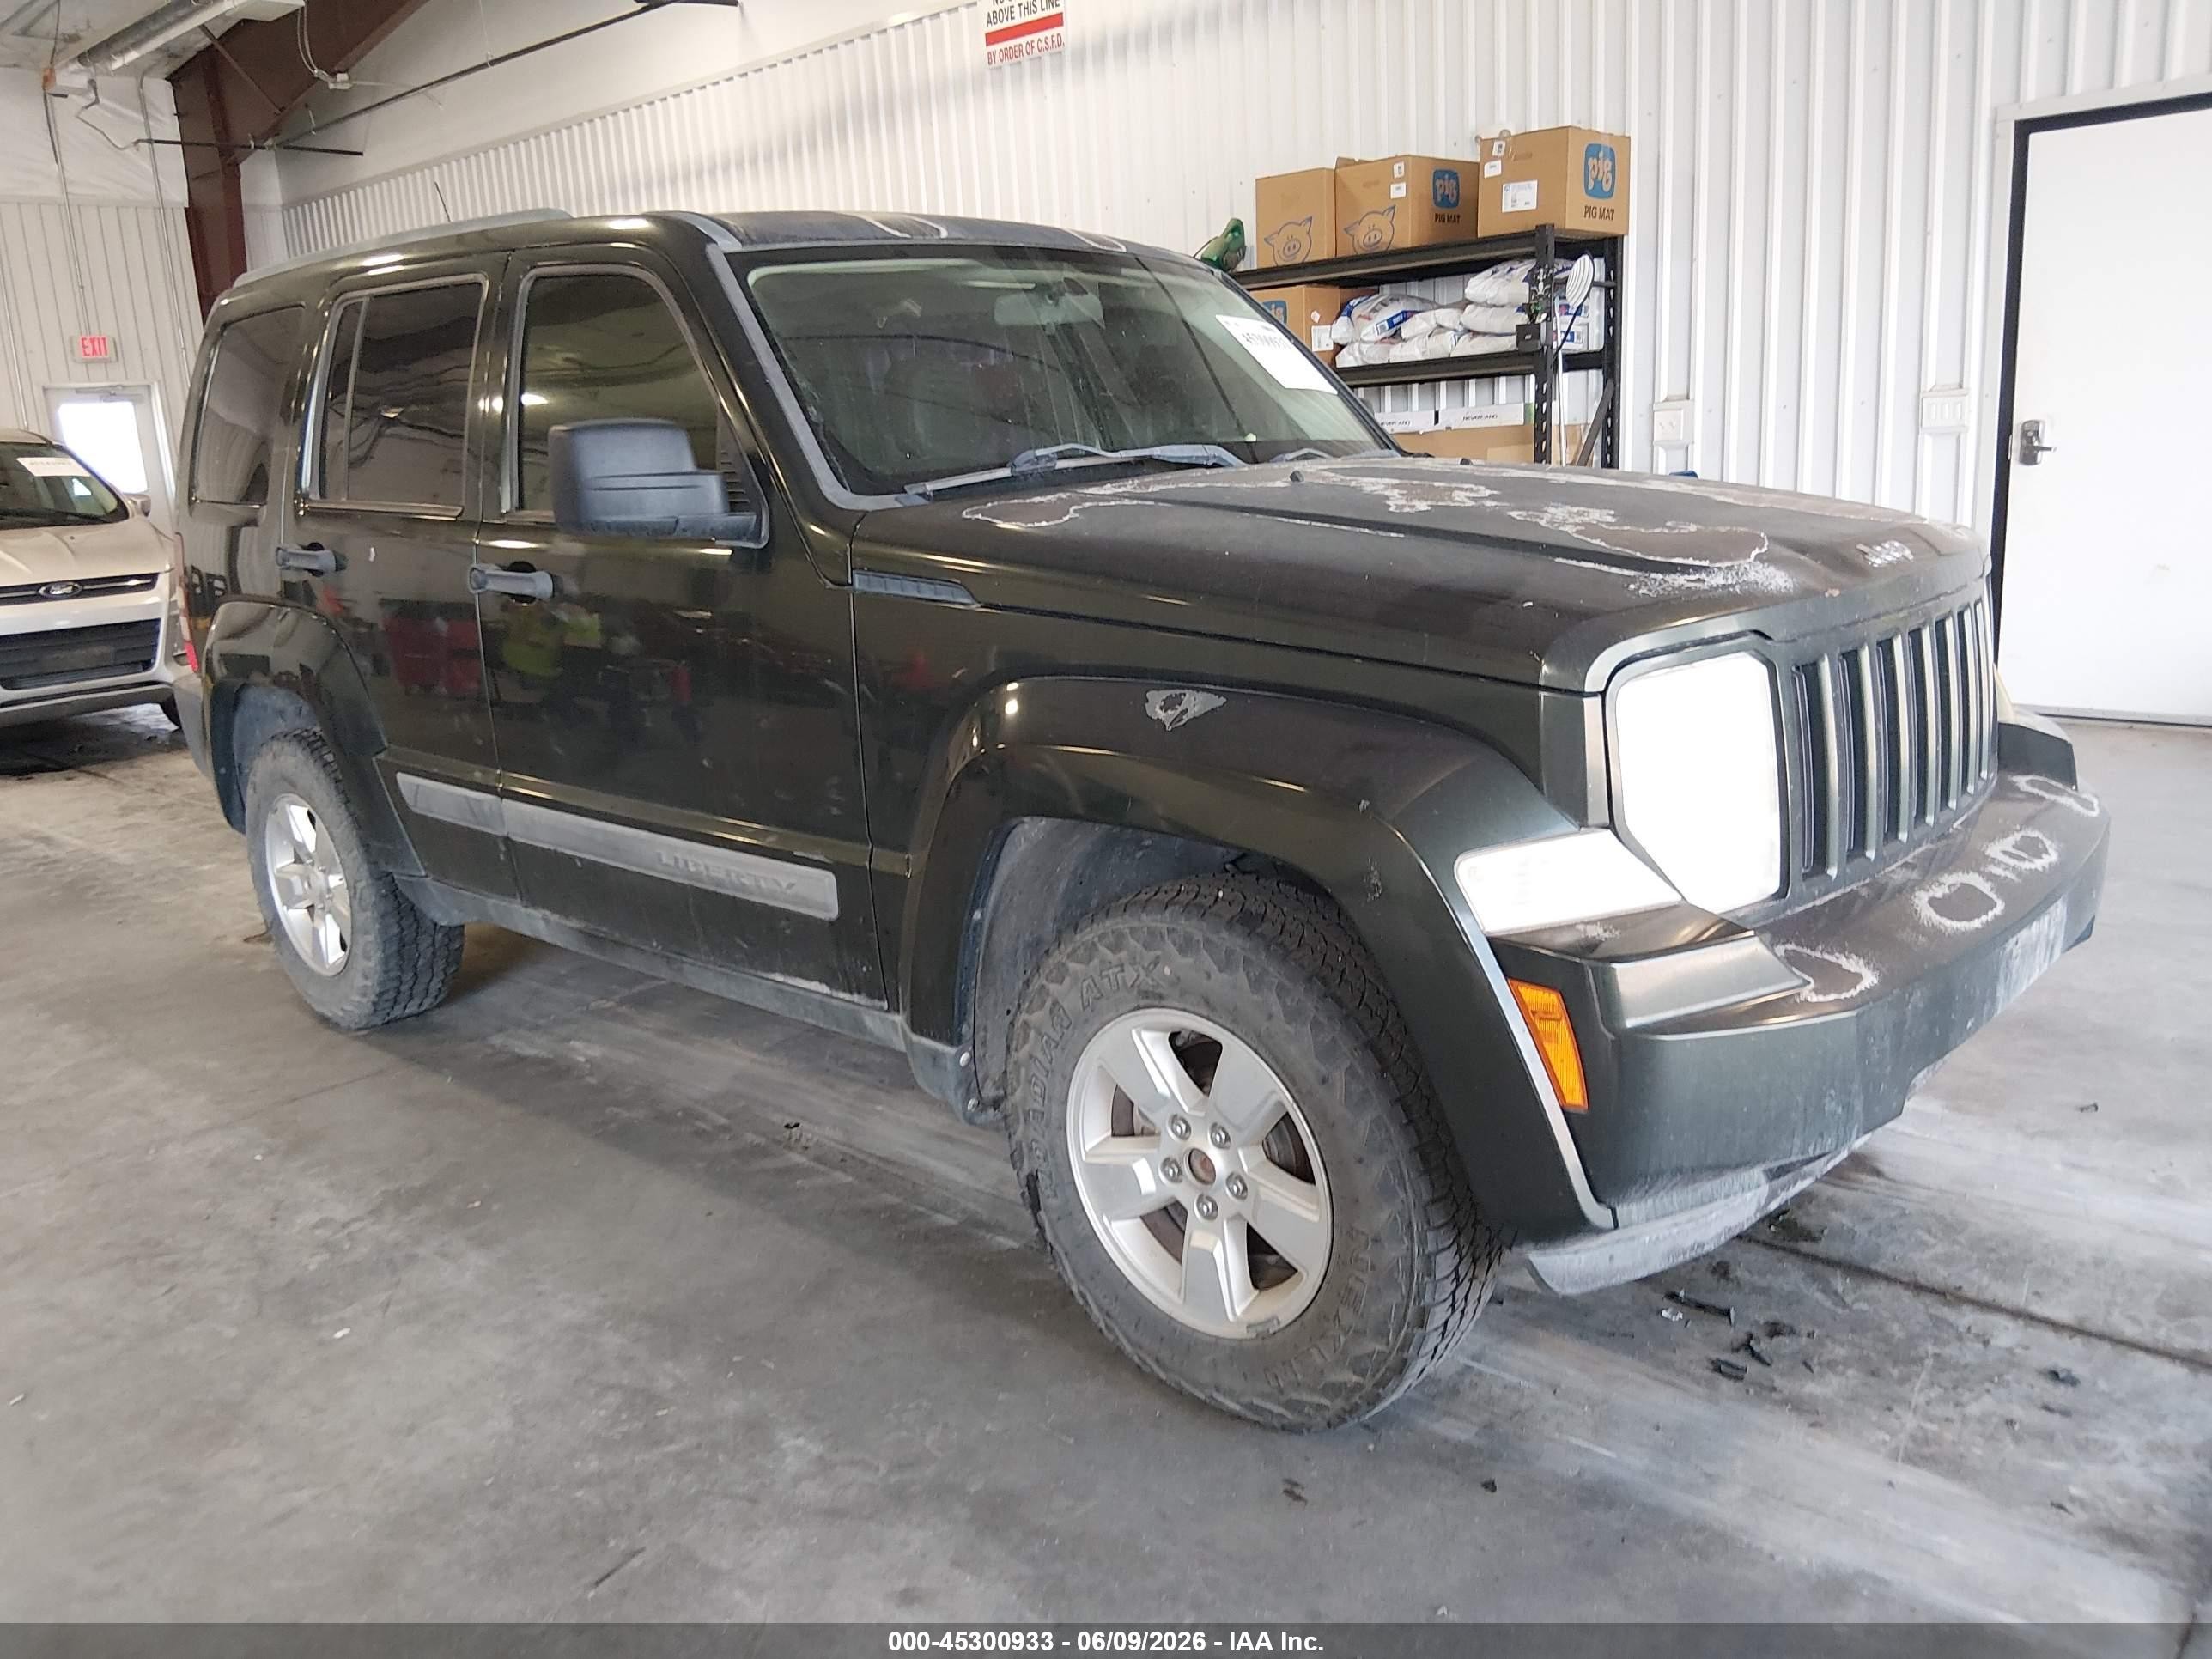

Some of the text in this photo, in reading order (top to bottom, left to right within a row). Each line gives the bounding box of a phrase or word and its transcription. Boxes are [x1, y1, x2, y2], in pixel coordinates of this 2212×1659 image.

[987, 5, 1016, 27] ABOVE
[1018, 0, 1038, 18] THIS
[988, 49, 997, 64] BY
[999, 43, 1024, 63] ORDER
[1025, 40, 1036, 56] OF
[1434, 213, 1462, 225] PIG MAT
[1583, 204, 1615, 222] PIG MAT
[81, 337, 109, 358] EXIT
[655, 850, 797, 894] LIBERTY
[1080, 955, 1163, 1012] ATX
